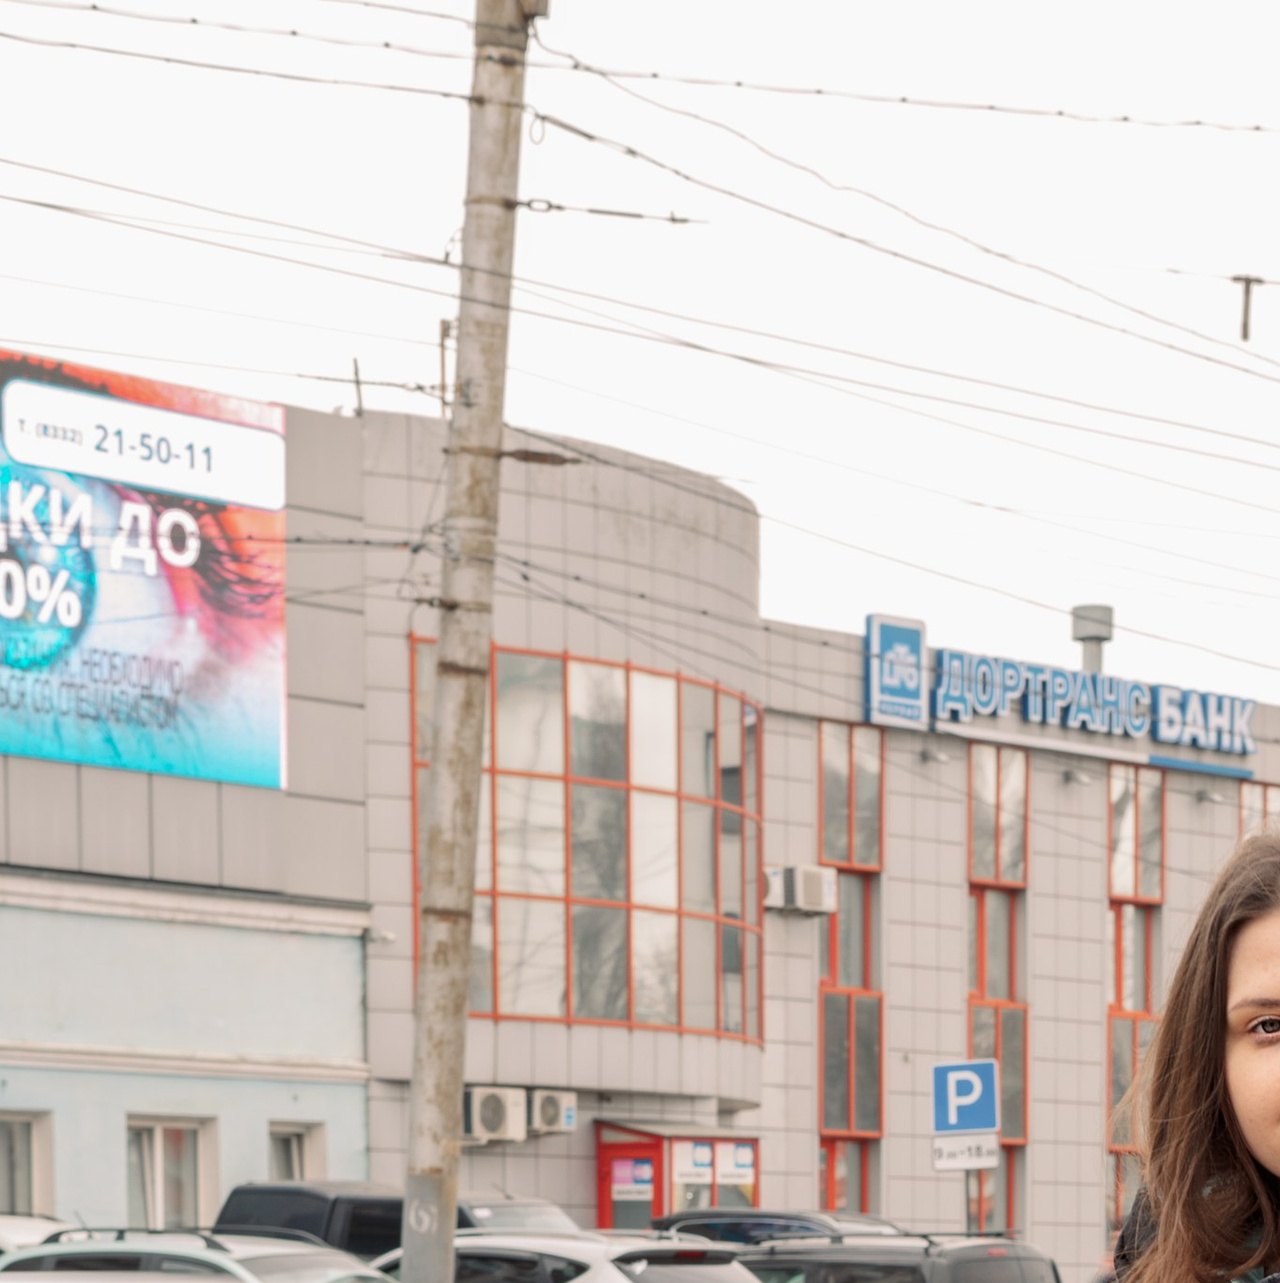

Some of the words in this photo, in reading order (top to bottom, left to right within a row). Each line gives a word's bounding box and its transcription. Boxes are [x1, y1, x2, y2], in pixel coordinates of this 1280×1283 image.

[94, 424, 213, 472] 21-50-11
[0, 480, 93, 552] КИ
[110, 500, 201, 577] ДО
[936, 649, 1150, 738] ДОРТРАНС
[1152, 684, 1256, 755] БАНК
[947, 1070, 983, 1125] P
